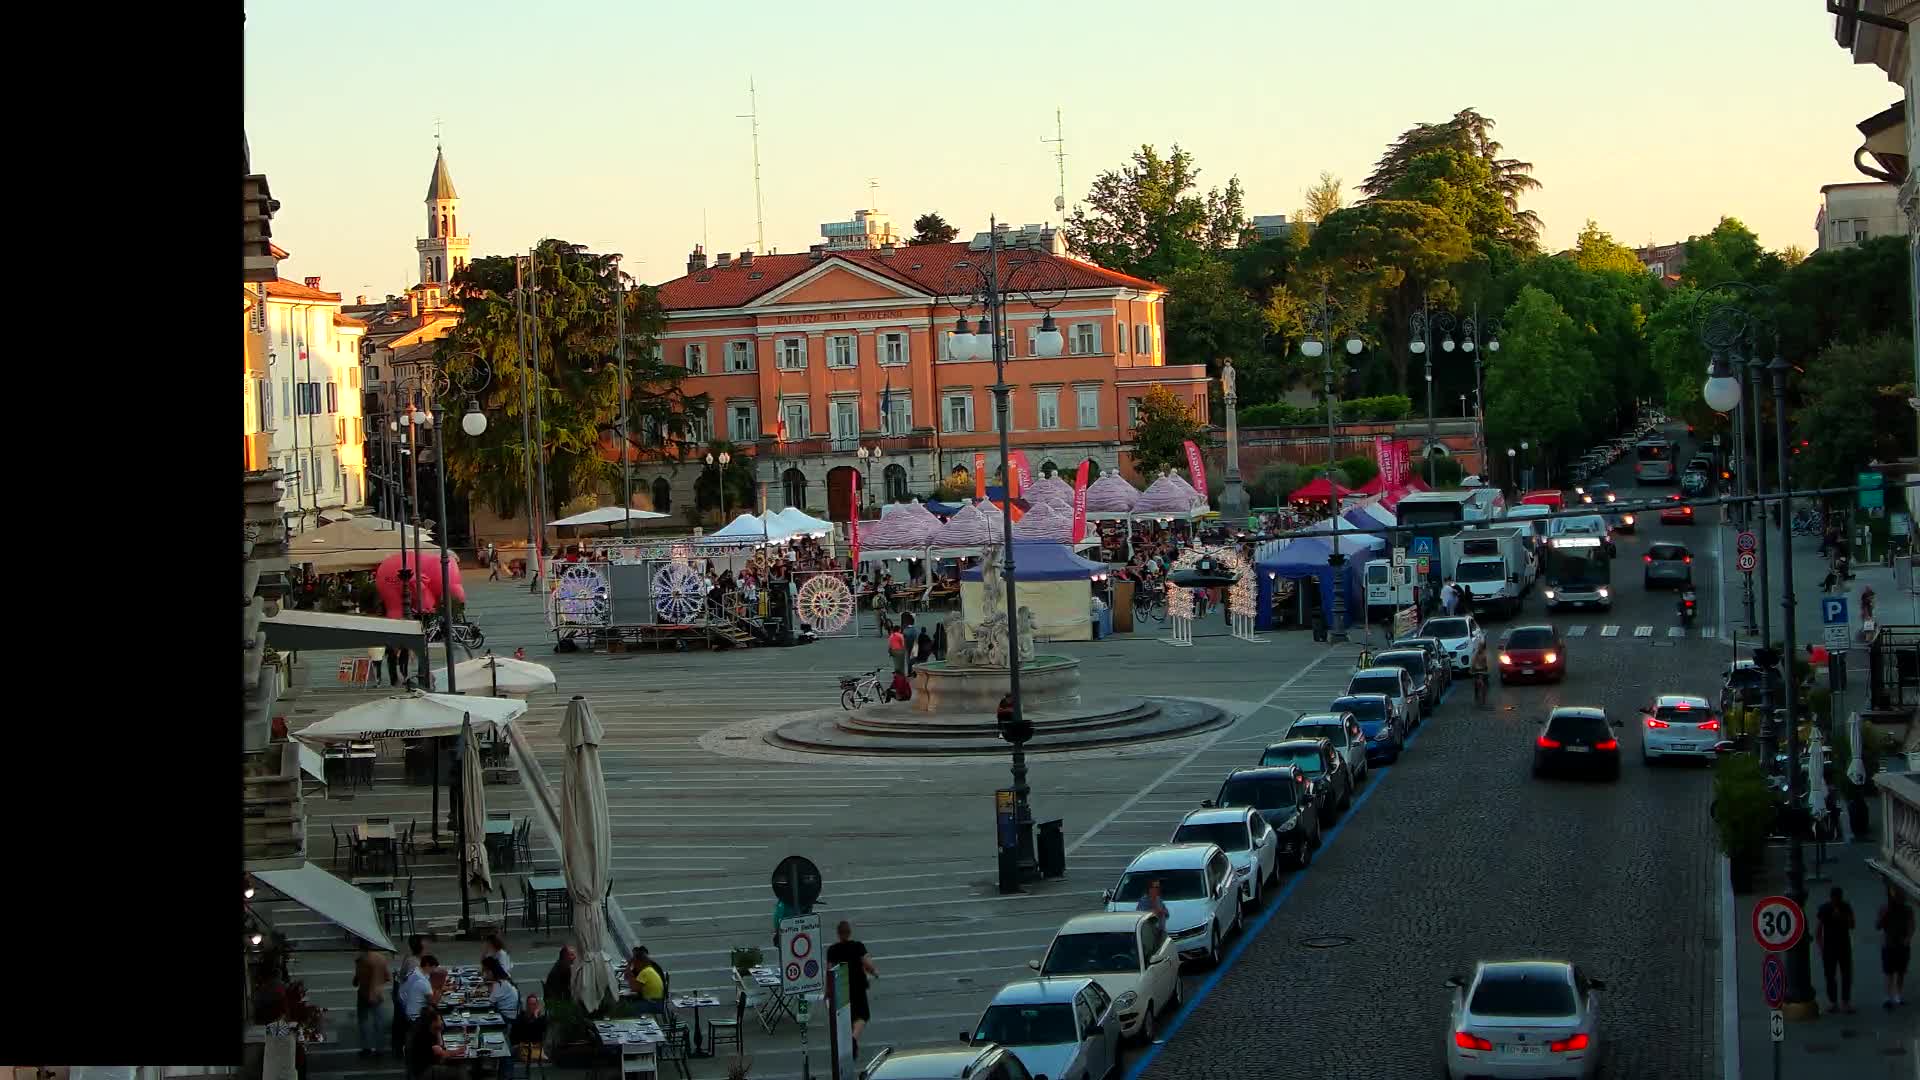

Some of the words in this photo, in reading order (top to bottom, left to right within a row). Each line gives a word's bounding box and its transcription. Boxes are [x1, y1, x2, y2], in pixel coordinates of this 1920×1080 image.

[1742, 556, 1753, 567] 20
[1827, 602, 1842, 621] P
[1762, 910, 1792, 937] 30
